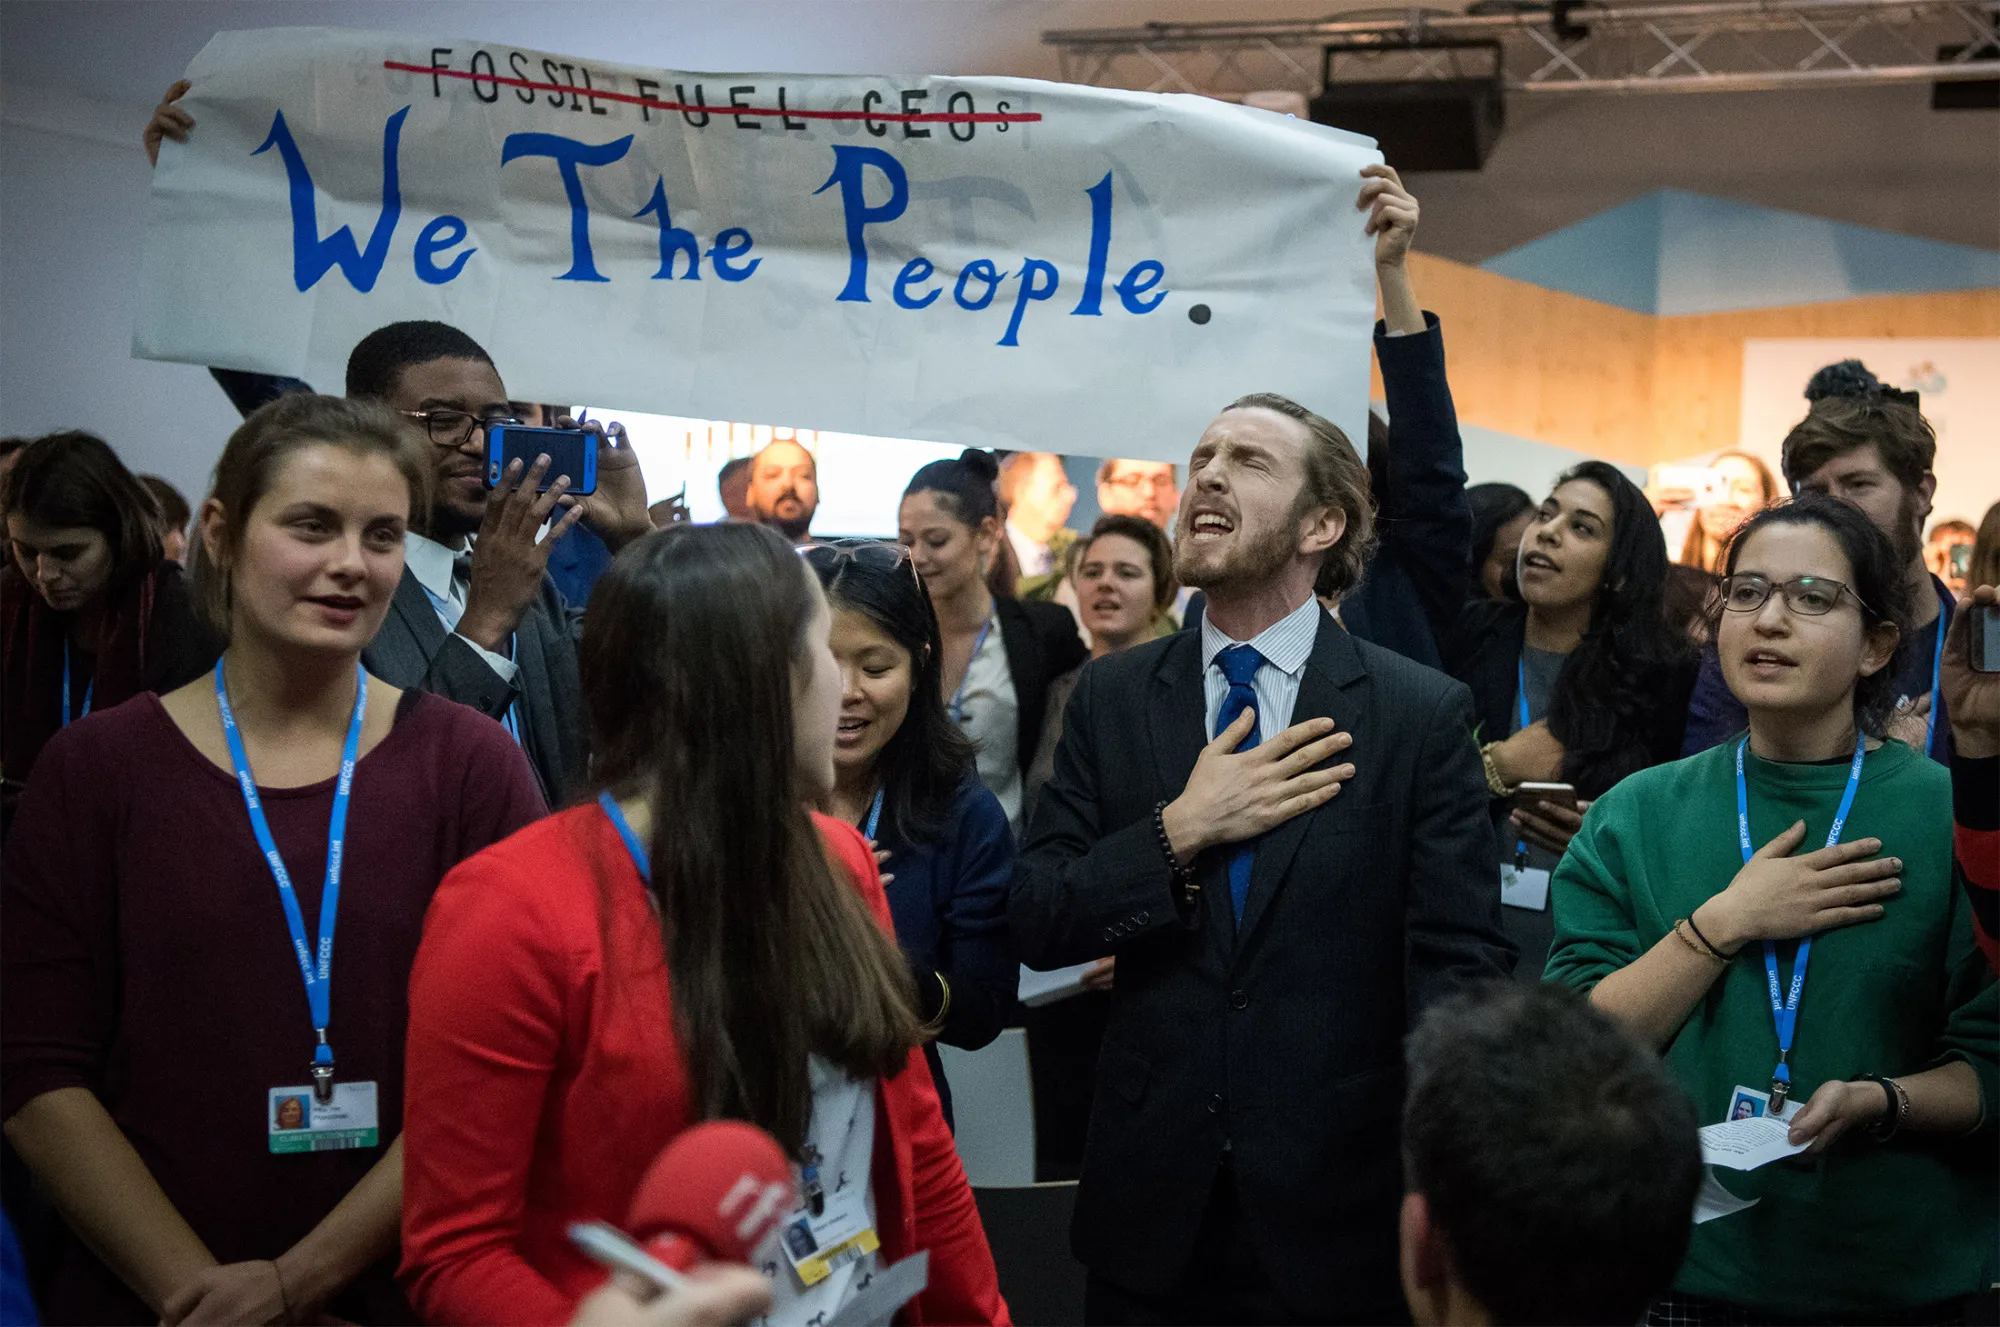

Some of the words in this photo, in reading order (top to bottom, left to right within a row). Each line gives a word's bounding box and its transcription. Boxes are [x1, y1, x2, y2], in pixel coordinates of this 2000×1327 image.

[431, 47, 608, 117] FOSSIL
[634, 78, 808, 131] FUEL
[861, 89, 1011, 142] CEOs
[252, 105, 477, 293] We
[501, 132, 763, 283] The
[813, 145, 1211, 347] People.
[1825, 818, 1843, 848] NFCCC
[1768, 970, 1783, 1011] unfccc.int
[1786, 974, 1803, 1011] UNFCCC
